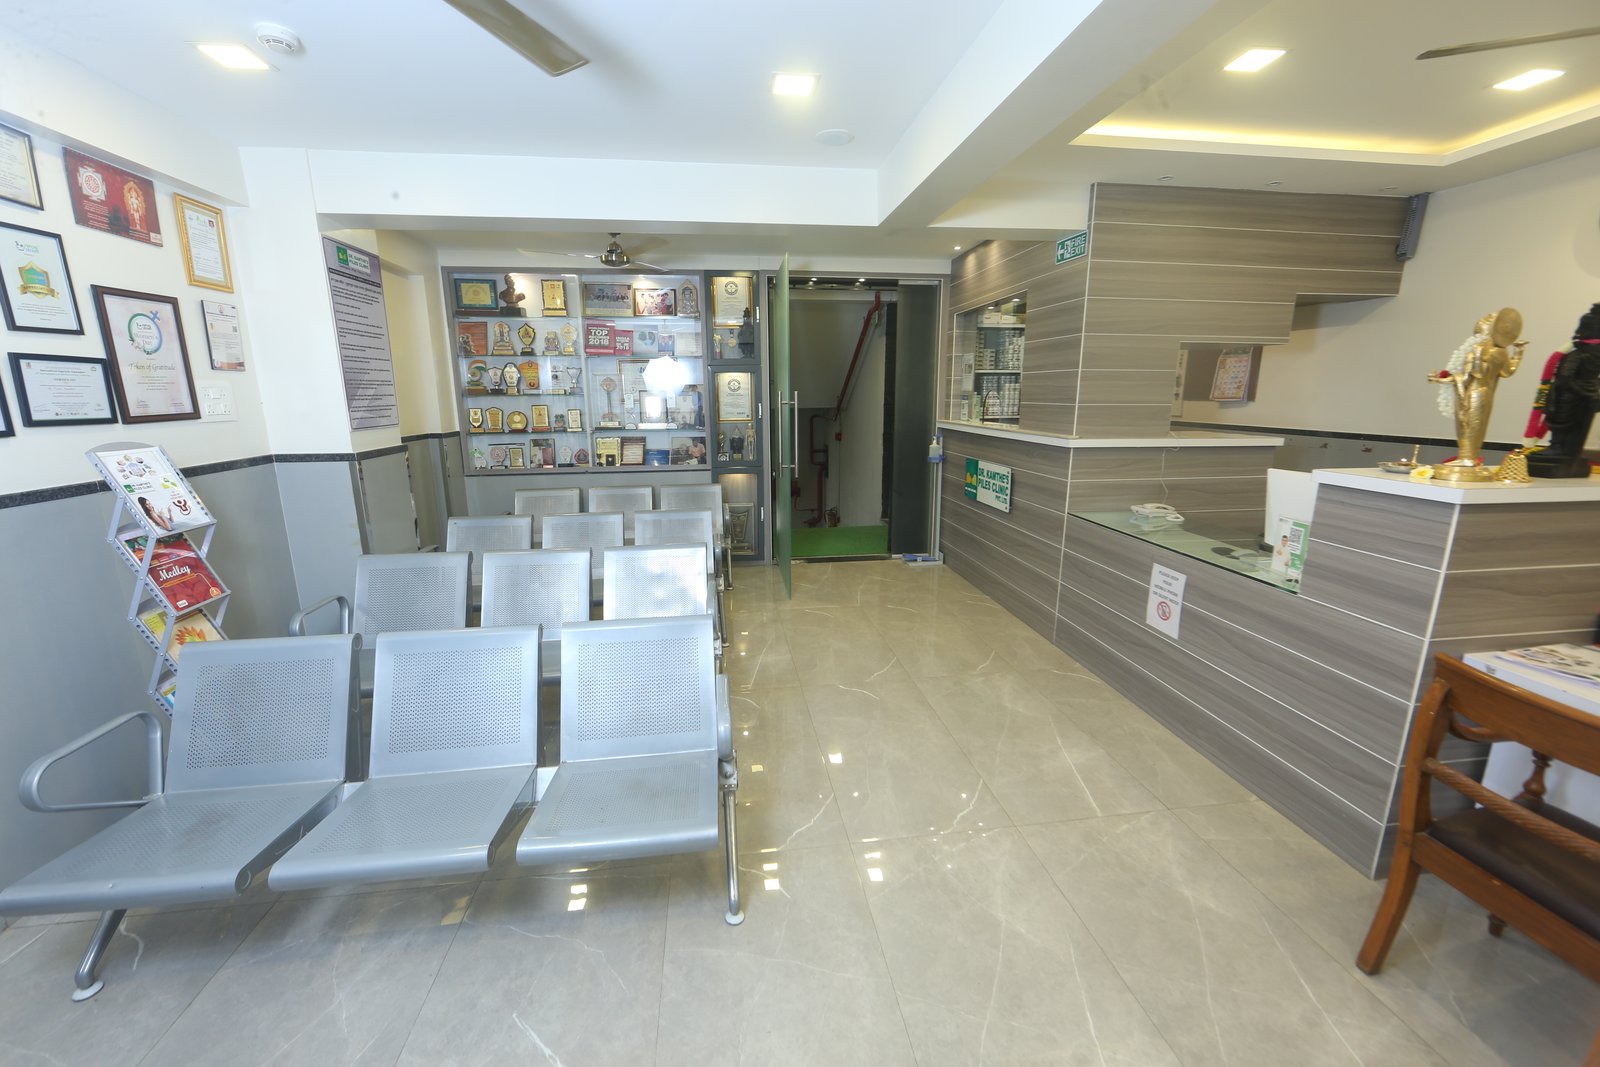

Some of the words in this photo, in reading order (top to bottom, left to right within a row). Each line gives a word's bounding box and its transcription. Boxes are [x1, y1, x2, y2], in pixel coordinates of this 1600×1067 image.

[1071, 234, 1087, 248] FIRE
[1070, 244, 1085, 256] EXIT
[978, 478, 991, 491] PILES
[992, 482, 1009, 497] CLINIC
[159, 565, 192, 582] Medley
